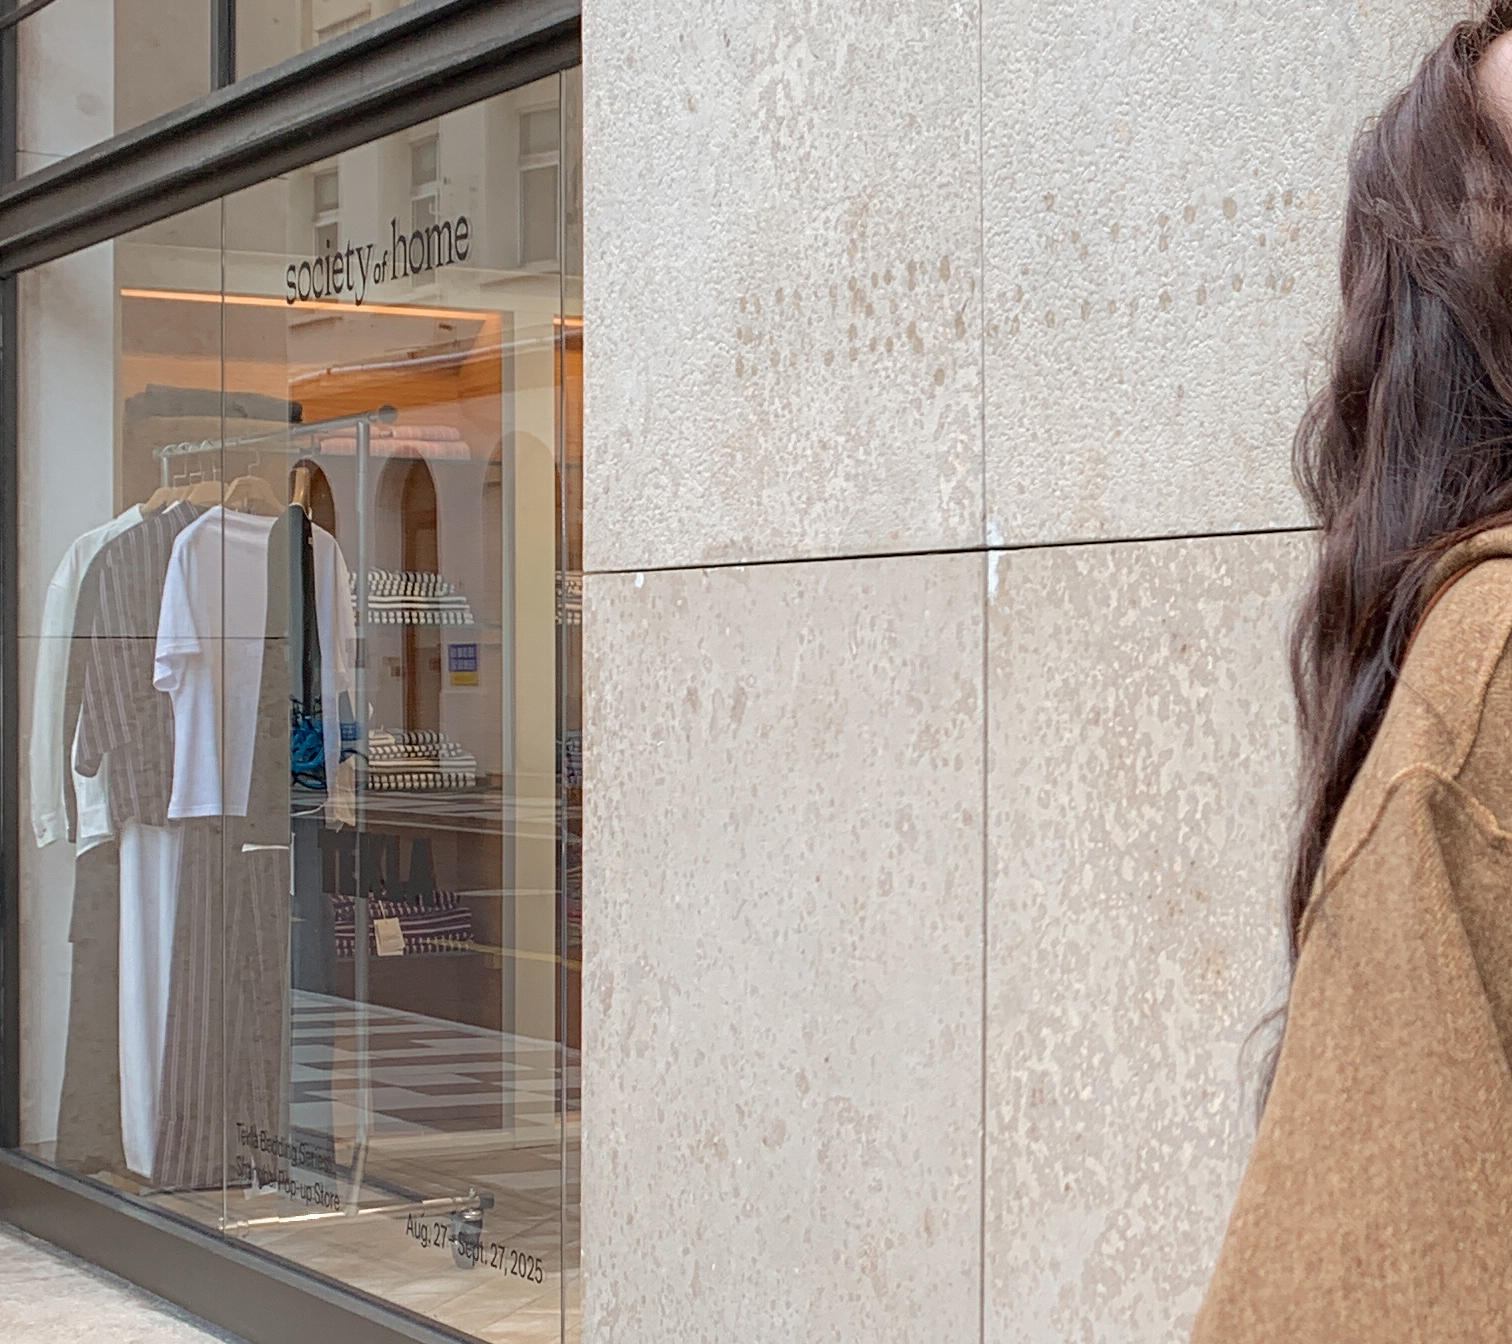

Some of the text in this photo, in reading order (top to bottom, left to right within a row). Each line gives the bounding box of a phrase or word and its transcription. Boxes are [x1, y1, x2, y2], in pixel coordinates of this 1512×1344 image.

[286, 216, 469, 306] society of home
[318, 828, 436, 907] TEKLA
[278, 1170, 312, 1207] Pop-up
[314, 1183, 340, 1211] Store
[406, 1213, 431, 1248] Aug.
[433, 1222, 447, 1248] 27
[458, 1231, 487, 1267] Sept.
[491, 1243, 507, 1276] 27,
[511, 1250, 543, 1284] 2025
